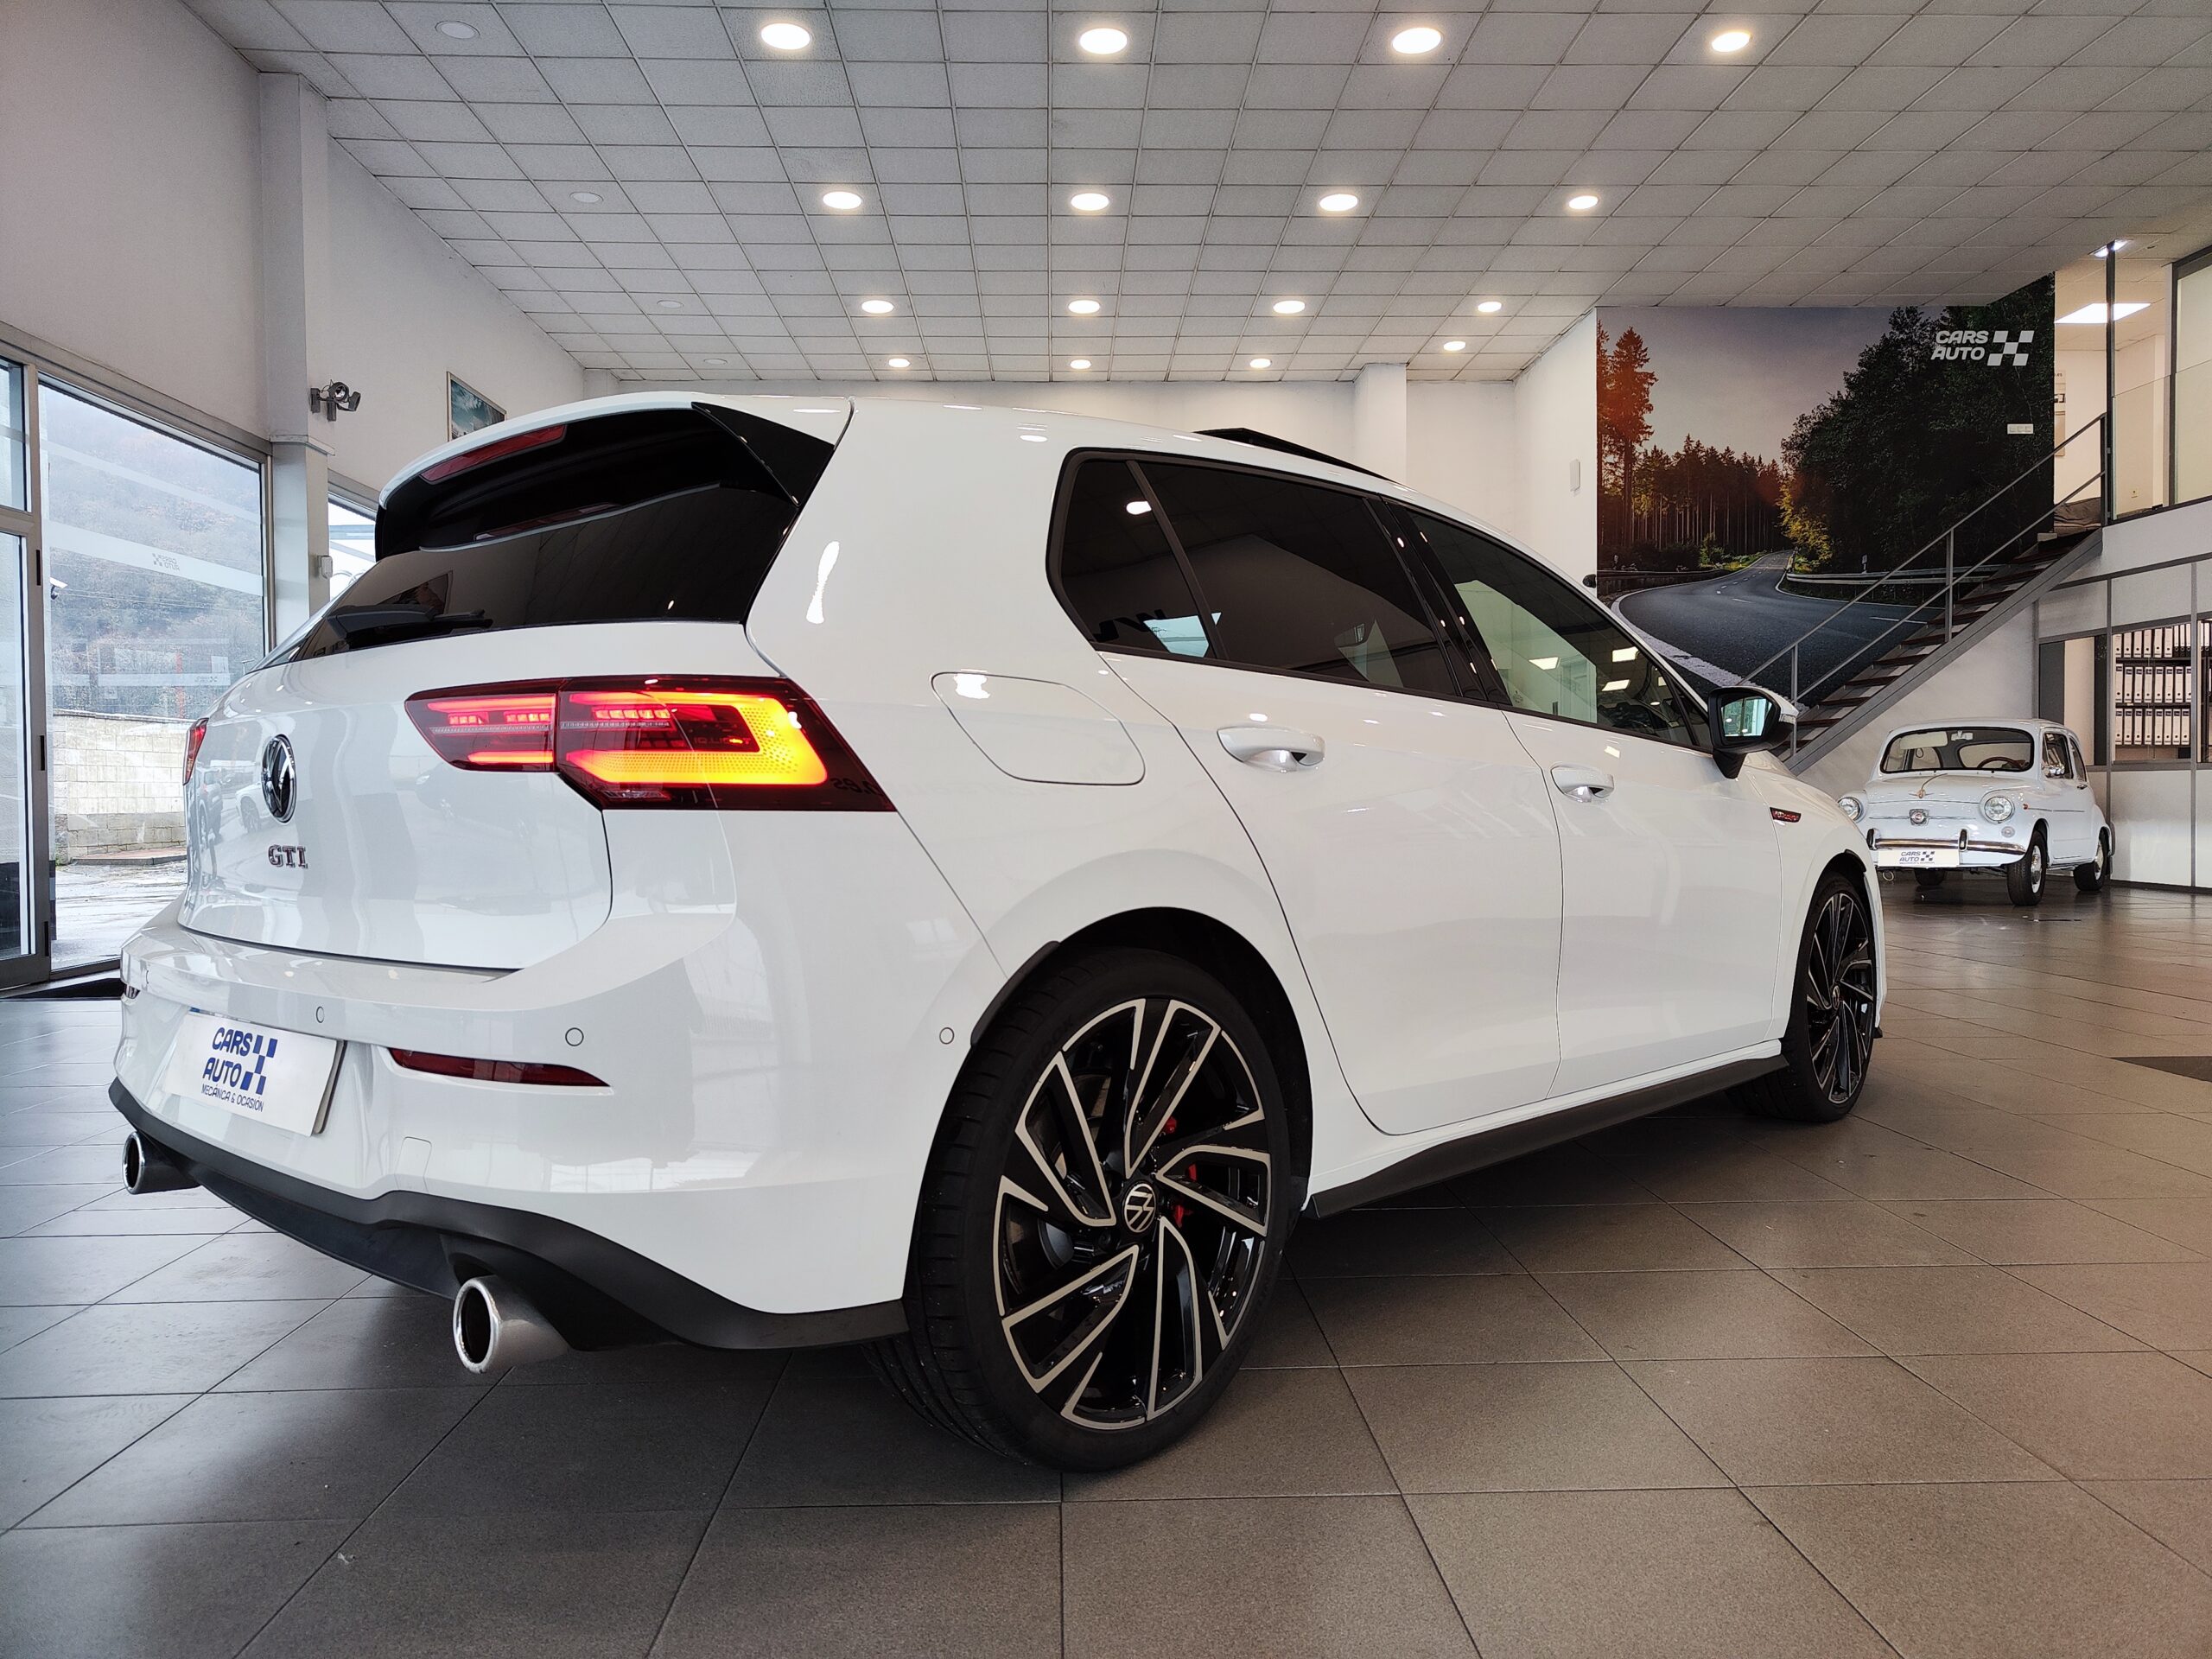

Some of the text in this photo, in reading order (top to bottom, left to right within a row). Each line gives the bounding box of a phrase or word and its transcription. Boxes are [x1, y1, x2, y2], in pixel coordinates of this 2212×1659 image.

[1936, 330, 1989, 344] CARS
[1930, 346, 1986, 360] AUTO
[269, 844, 308, 869] GTI
[212, 1027, 253, 1057] CARS
[202, 1057, 242, 1087] AUTO
[231, 1092, 236, 1103] &
